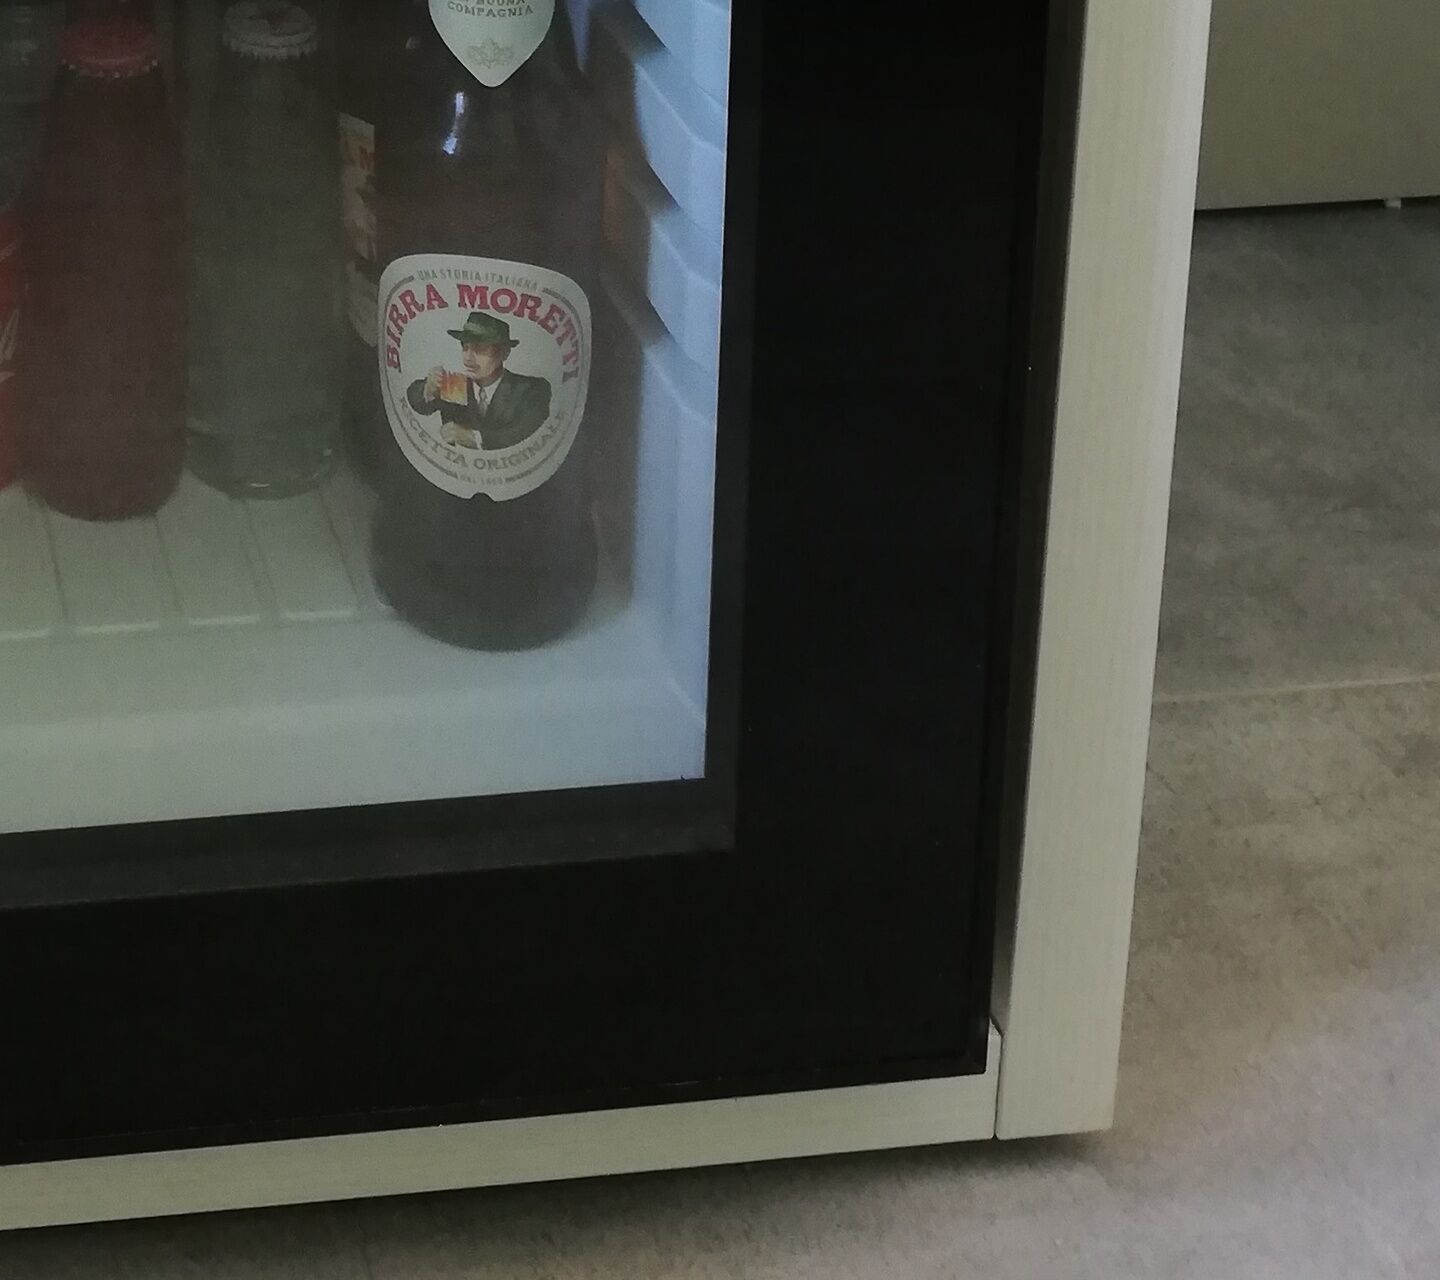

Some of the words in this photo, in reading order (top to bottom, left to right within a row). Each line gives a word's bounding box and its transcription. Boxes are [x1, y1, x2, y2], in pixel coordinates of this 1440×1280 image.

[448, 1, 534, 18] COMPAGNIA
[439, 268, 482, 282] STORIA
[386, 283, 449, 374] BIRRA
[456, 283, 580, 384] MORETTI
